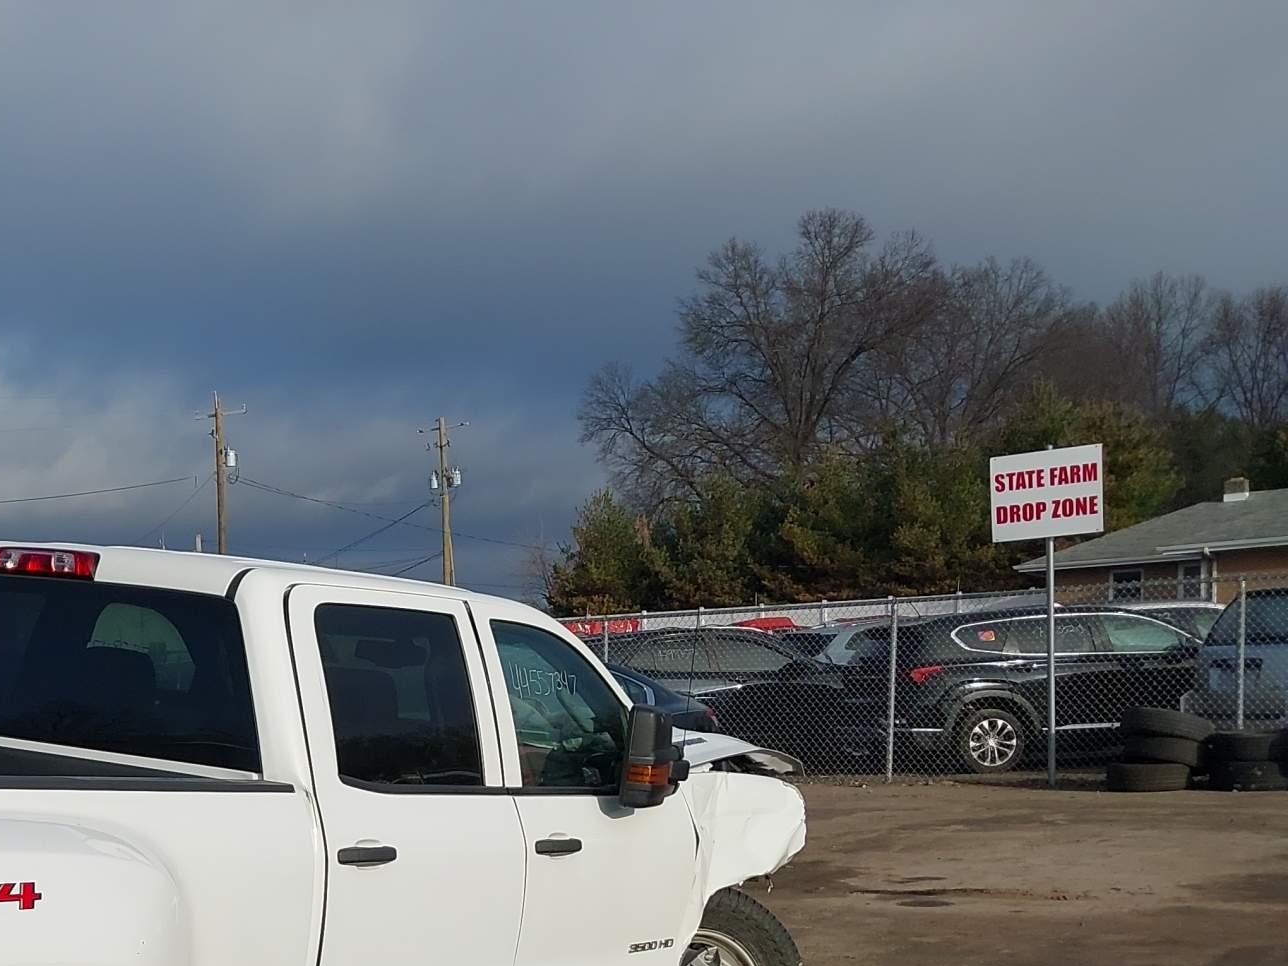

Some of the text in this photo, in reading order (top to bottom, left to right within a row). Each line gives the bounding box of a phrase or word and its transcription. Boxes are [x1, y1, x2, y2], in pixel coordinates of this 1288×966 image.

[994, 462, 1098, 493] STATE FARM
[996, 495, 1098, 525] DROP ZONE
[508, 660, 577, 699] 44557347
[628, 938, 674, 954] 3500 HD
